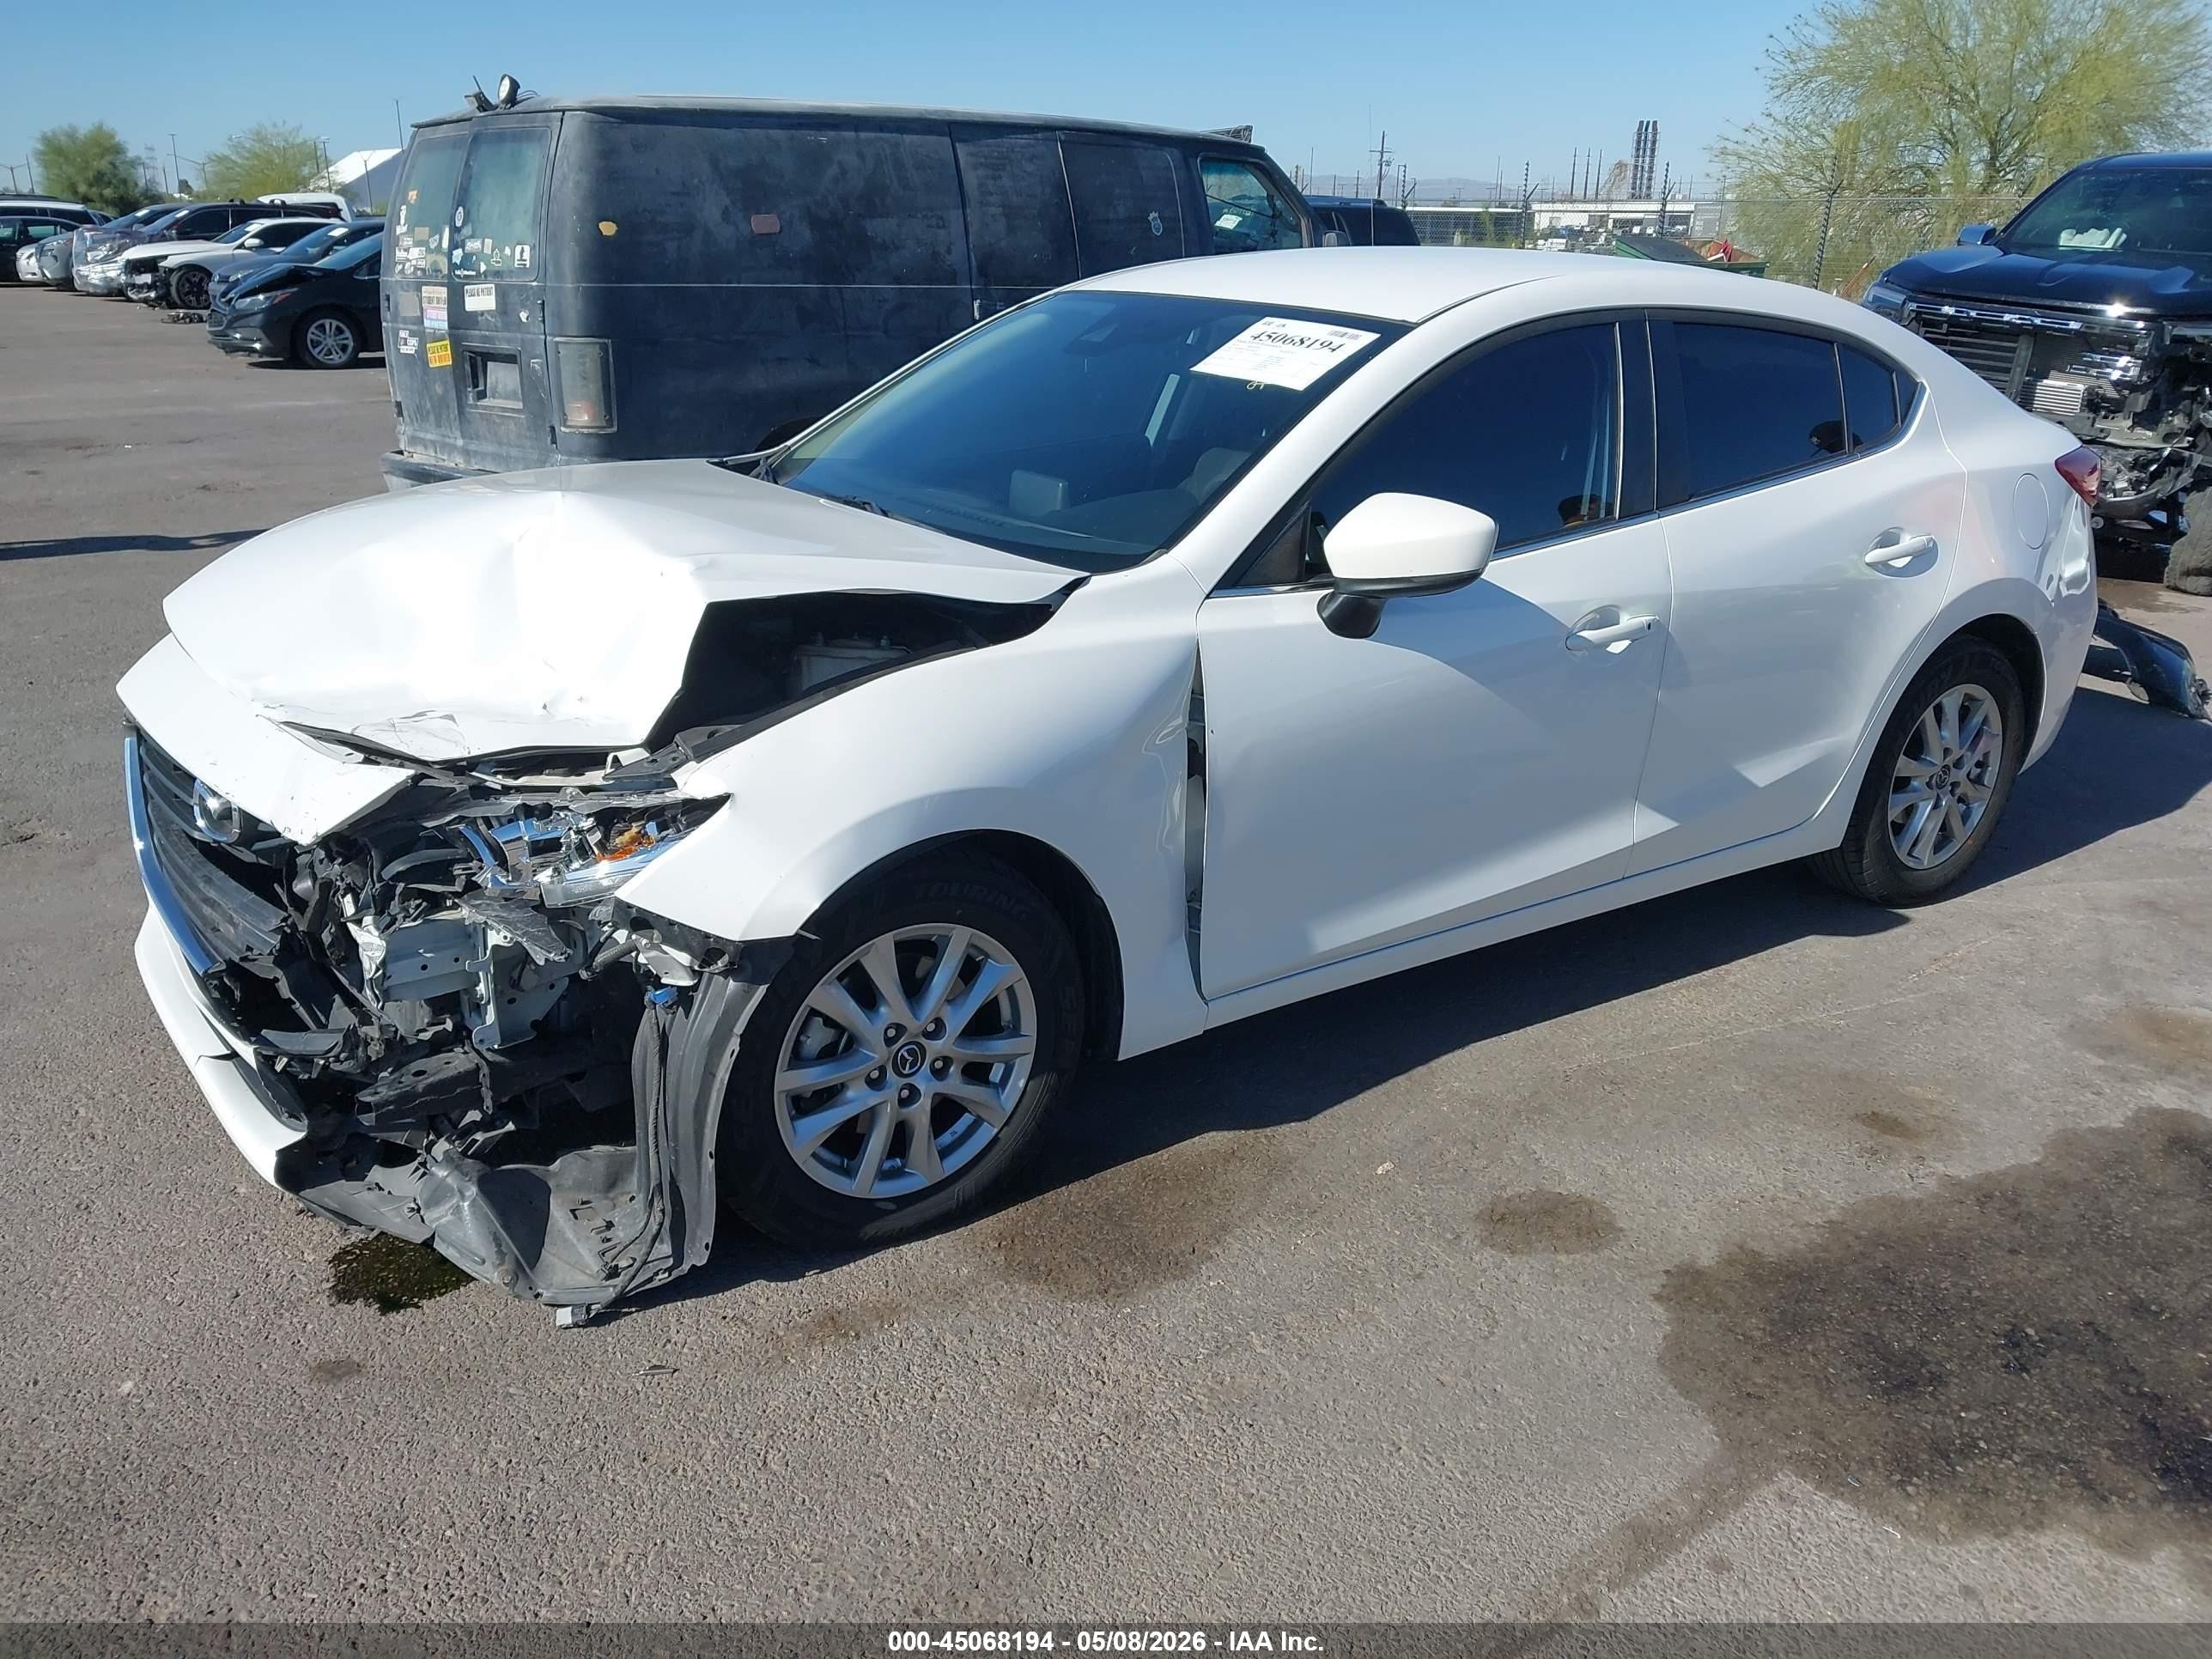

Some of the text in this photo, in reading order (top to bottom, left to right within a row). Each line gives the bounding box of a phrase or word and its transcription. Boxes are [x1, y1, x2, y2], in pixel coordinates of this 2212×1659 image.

[465, 288, 476, 297] PLEASE
[481, 286, 494, 296] PATIENT
[1250, 331, 1346, 352] 45068194
